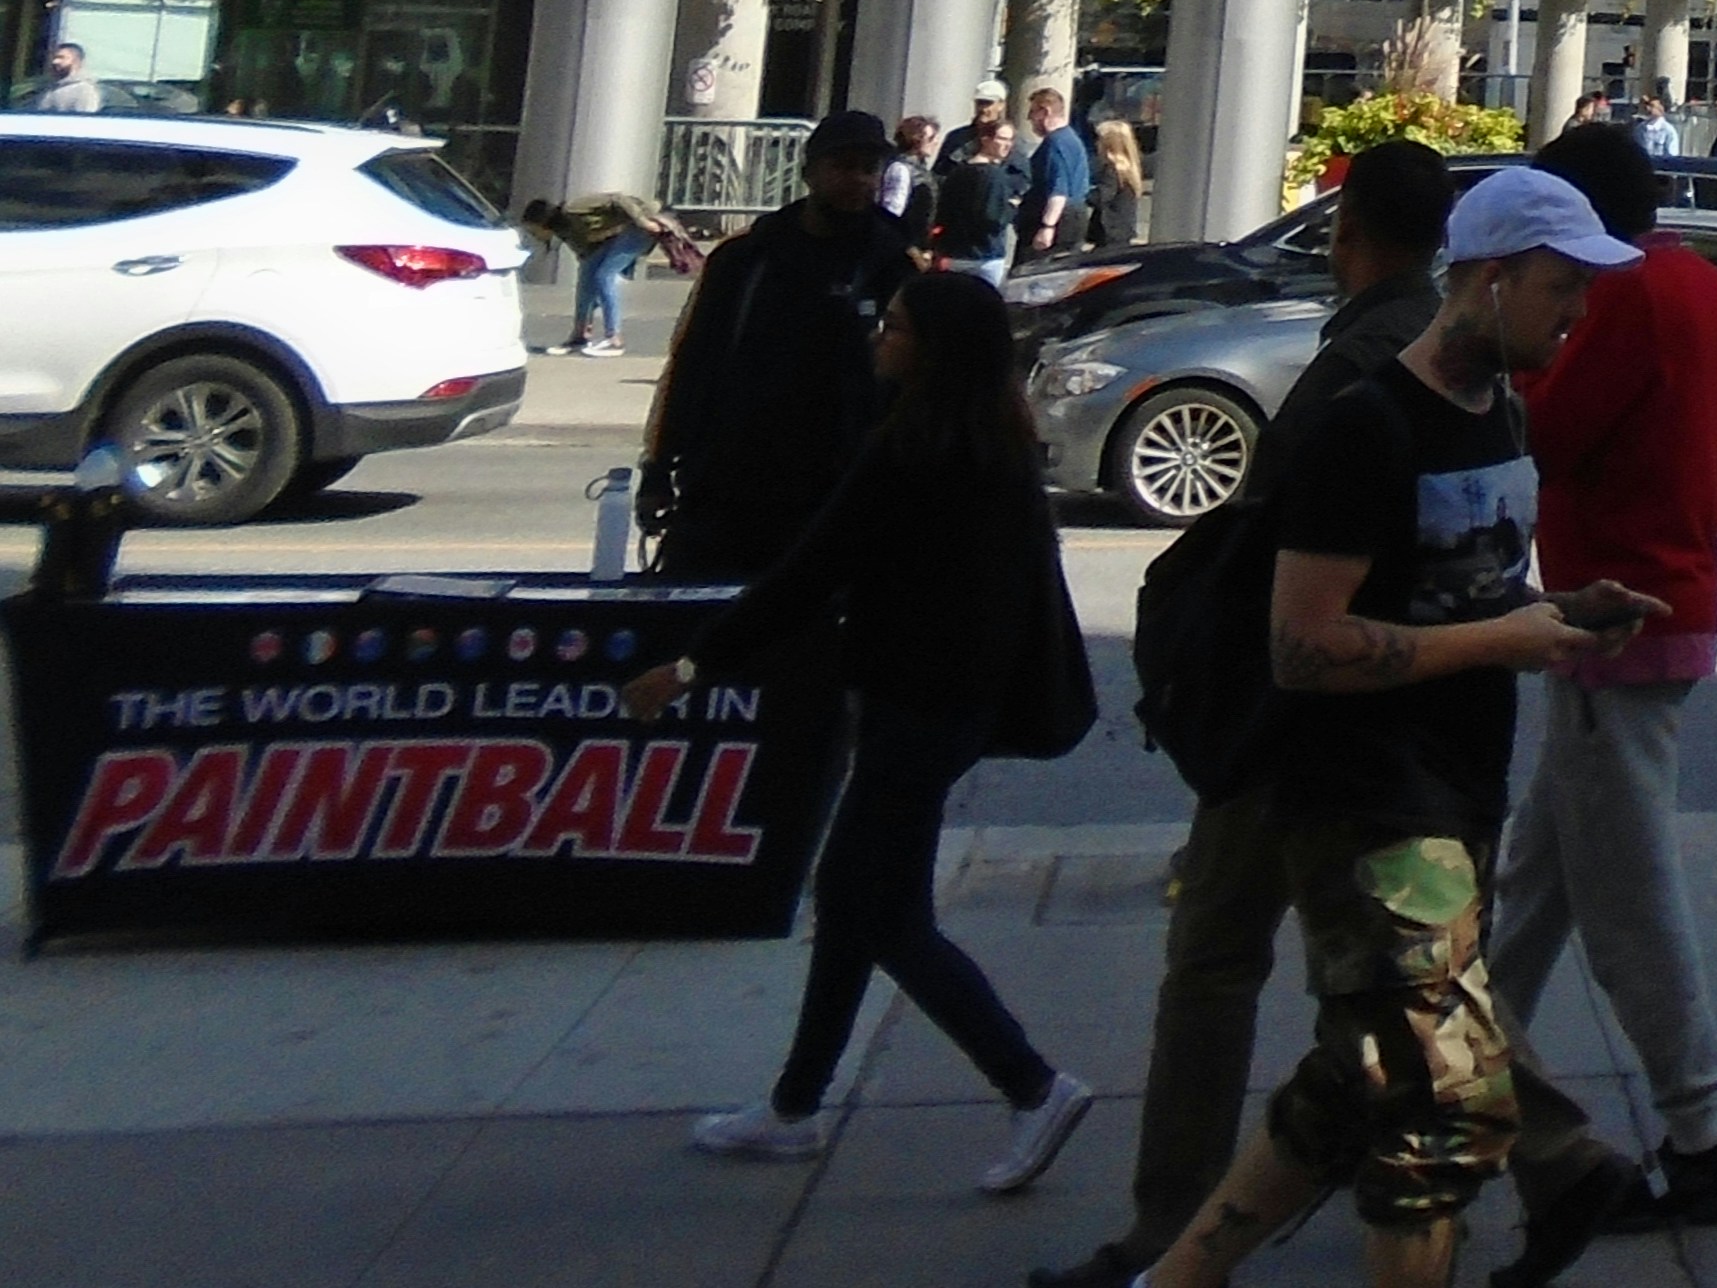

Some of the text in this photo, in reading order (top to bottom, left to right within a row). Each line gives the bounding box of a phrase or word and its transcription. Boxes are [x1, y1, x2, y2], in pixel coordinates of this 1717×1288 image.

[108, 682, 761, 729] THE WORLD LEADR IN
[49, 737, 763, 881] PAINTBALL
